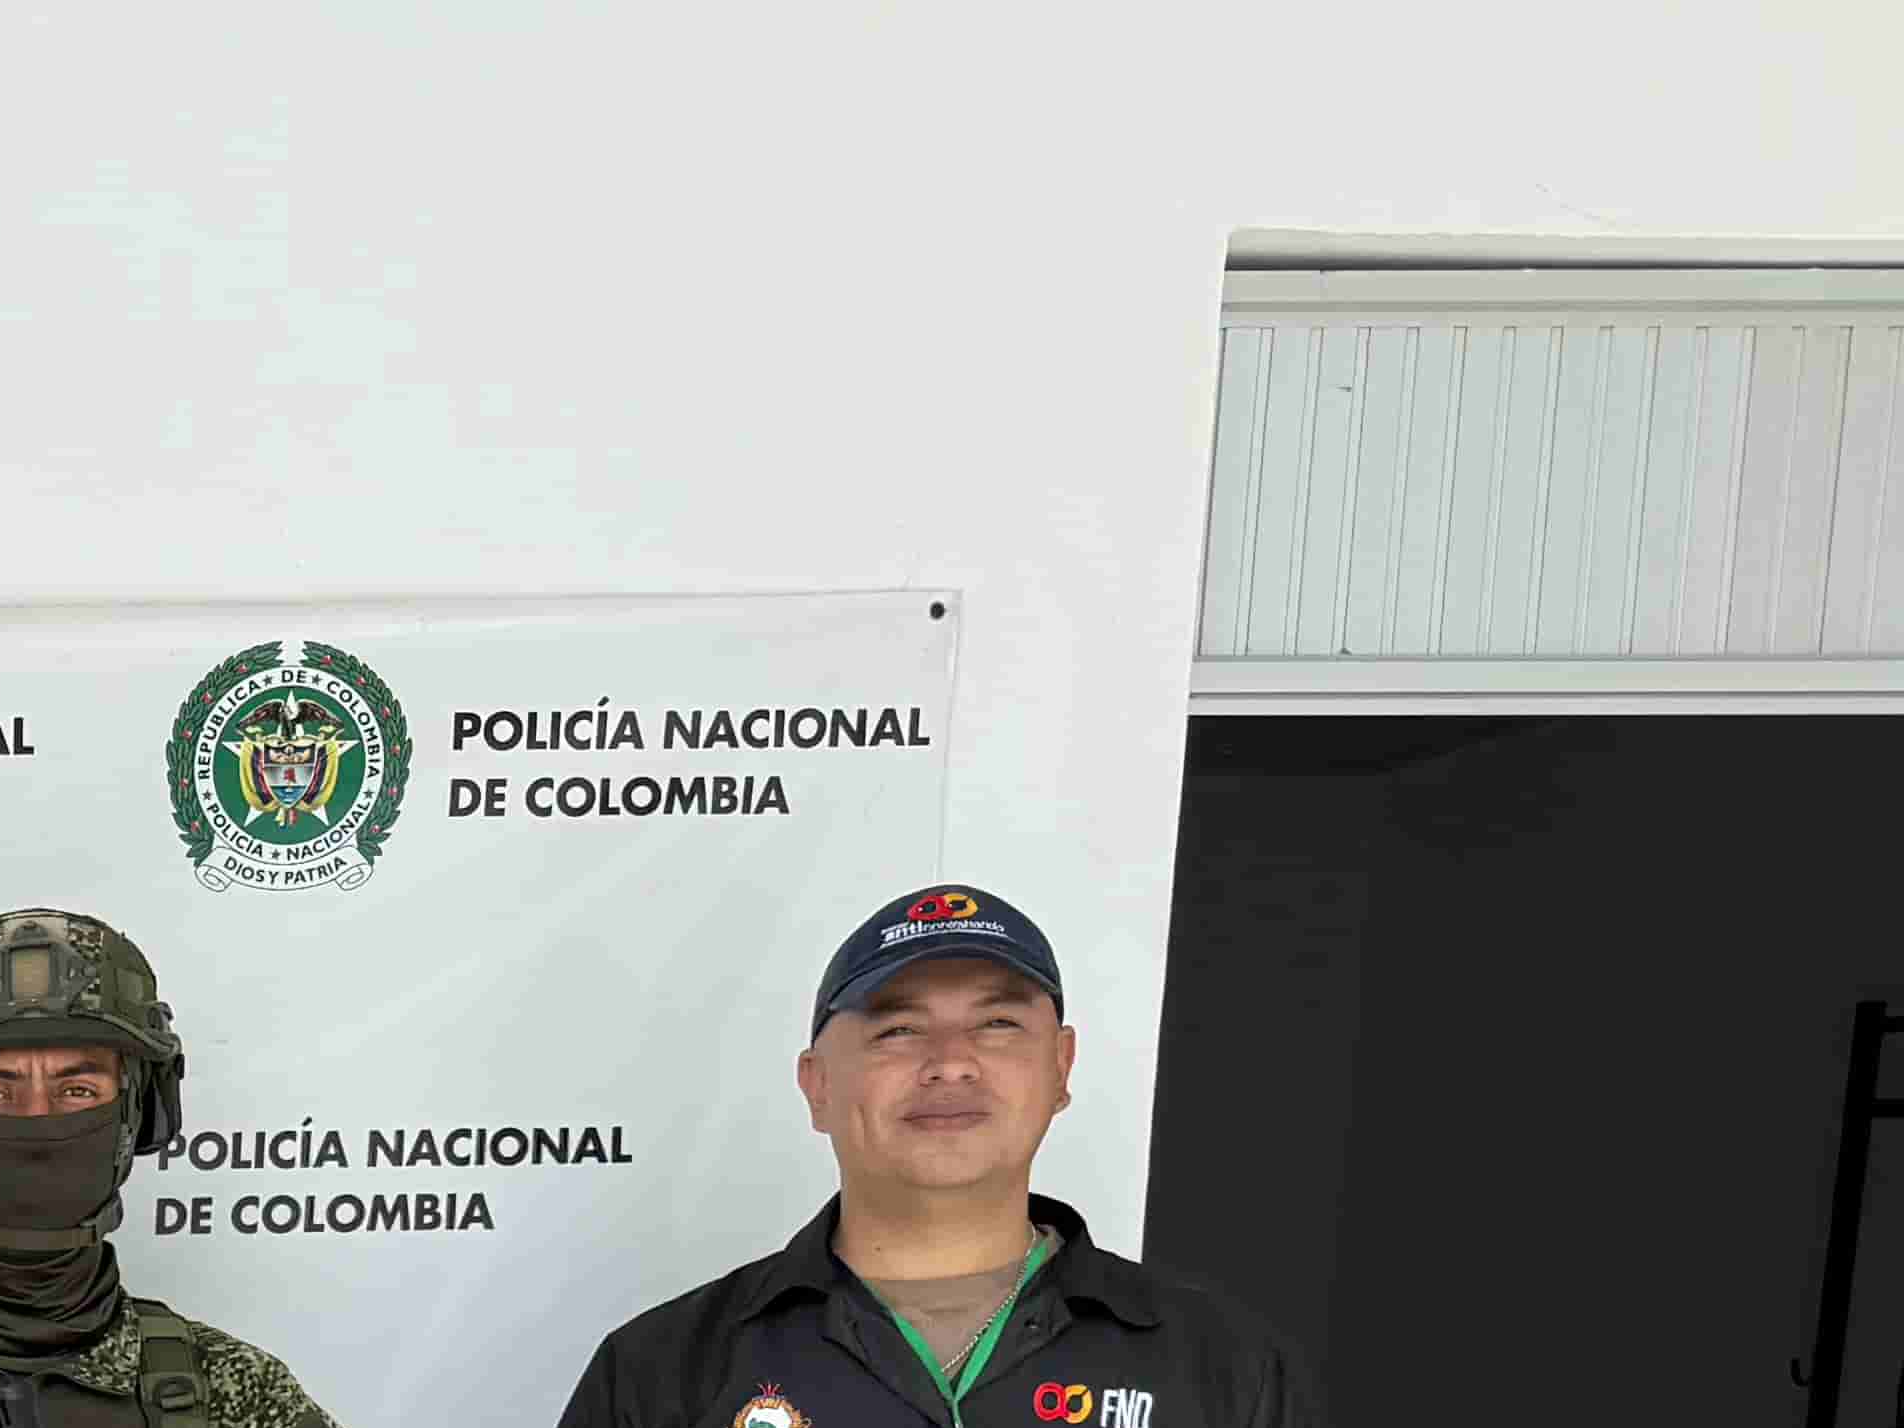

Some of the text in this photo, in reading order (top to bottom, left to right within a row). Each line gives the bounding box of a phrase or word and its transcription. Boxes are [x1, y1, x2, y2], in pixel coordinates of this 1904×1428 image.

[199, 669, 382, 780] REPUBLICA DE COLOMBIA
[452, 696, 931, 751] POLICÍA NACIONAL
[448, 775, 790, 818] DE COLOMBIA
[206, 803, 368, 860] POLICIA NACIONAL
[284, 857, 349, 884] PATRIA
[160, 1117, 633, 1171] POLICÍA NACIONAL
[154, 1192, 495, 1236] DE COLOMBIA
